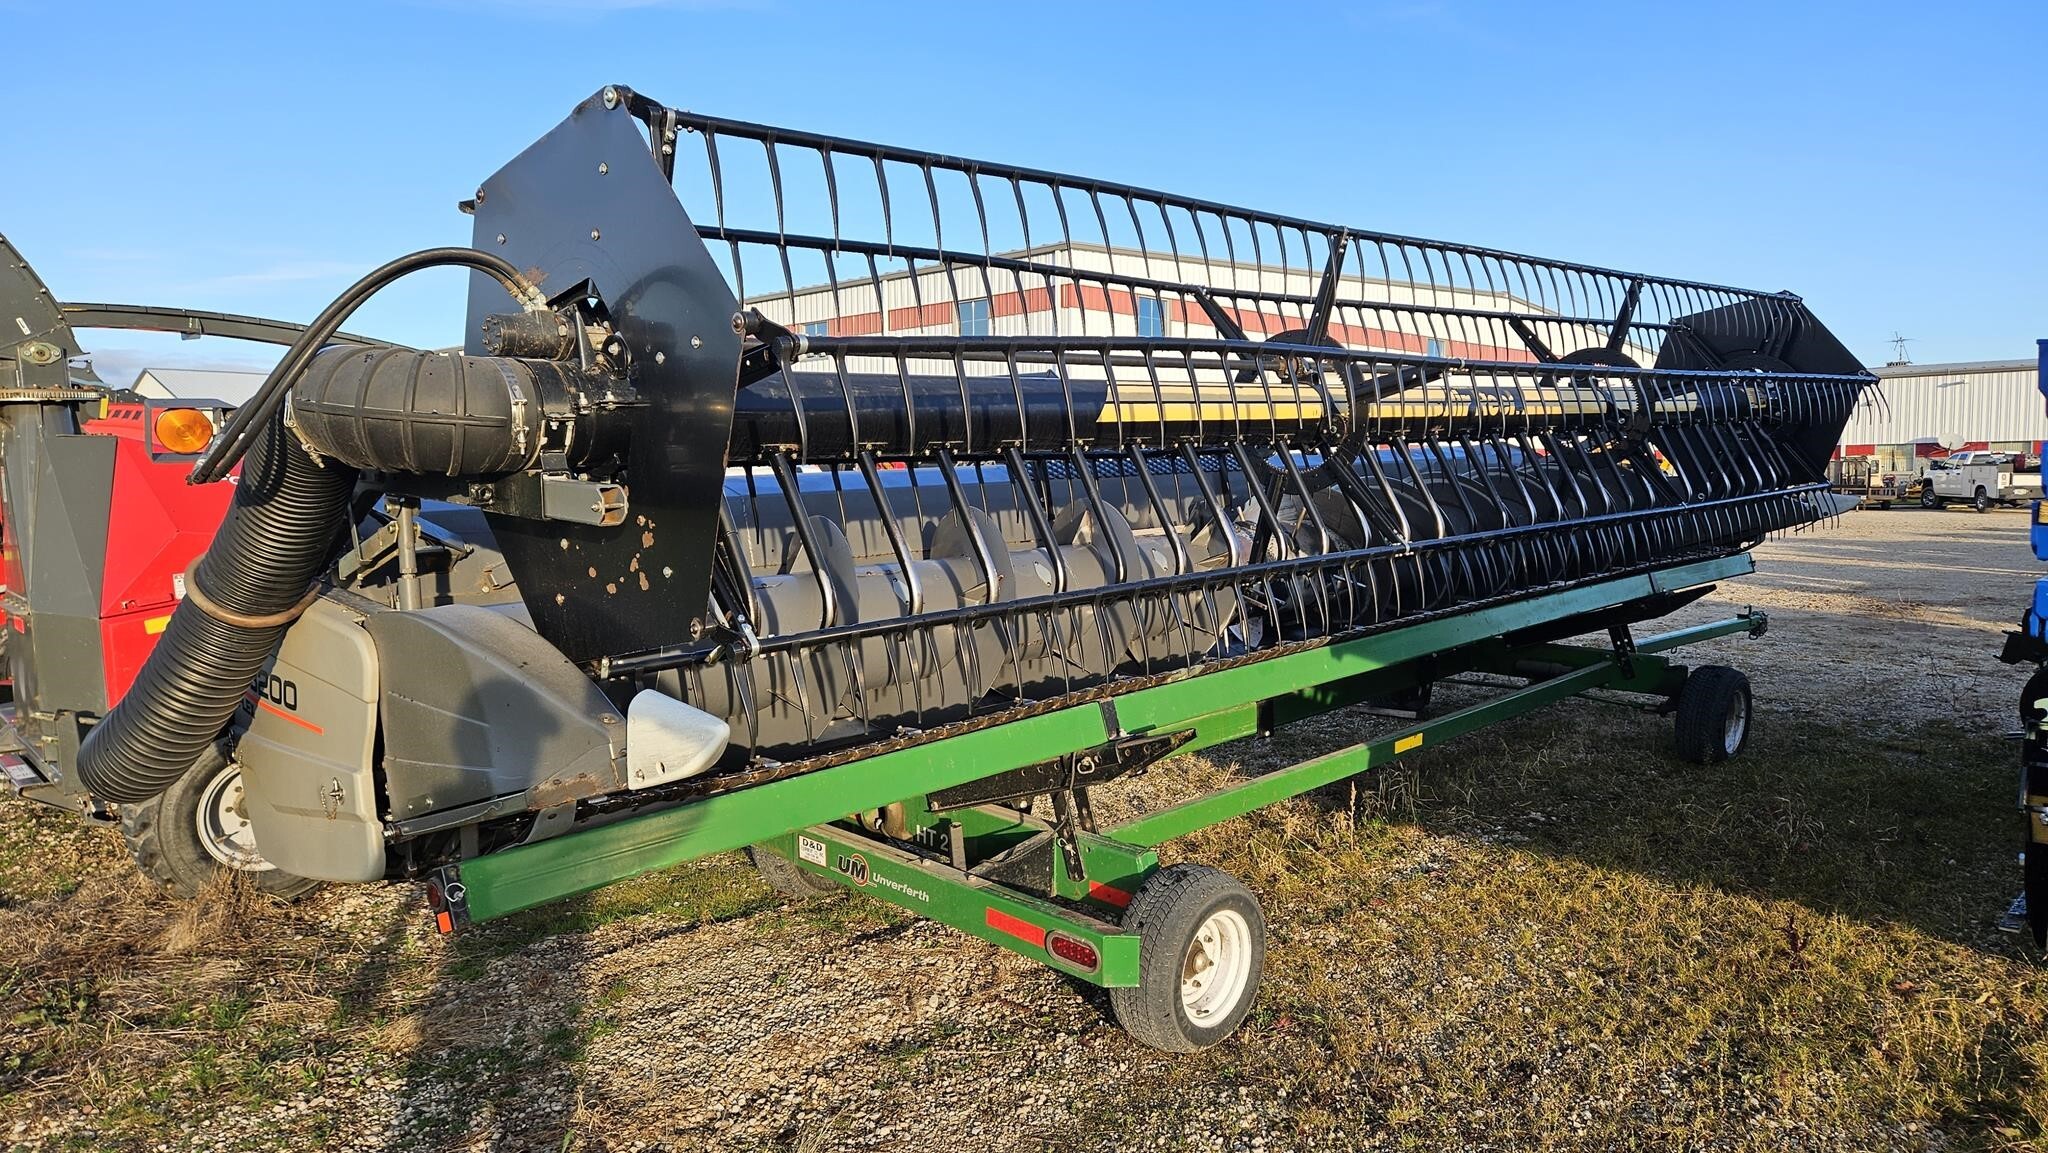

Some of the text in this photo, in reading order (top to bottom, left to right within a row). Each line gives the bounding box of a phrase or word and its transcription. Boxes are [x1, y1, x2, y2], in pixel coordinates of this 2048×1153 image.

[802, 838, 823, 852] D&D
[916, 824, 937, 847] HT
[838, 855, 866, 880] UM
[872, 872, 930, 903] Unverferth
